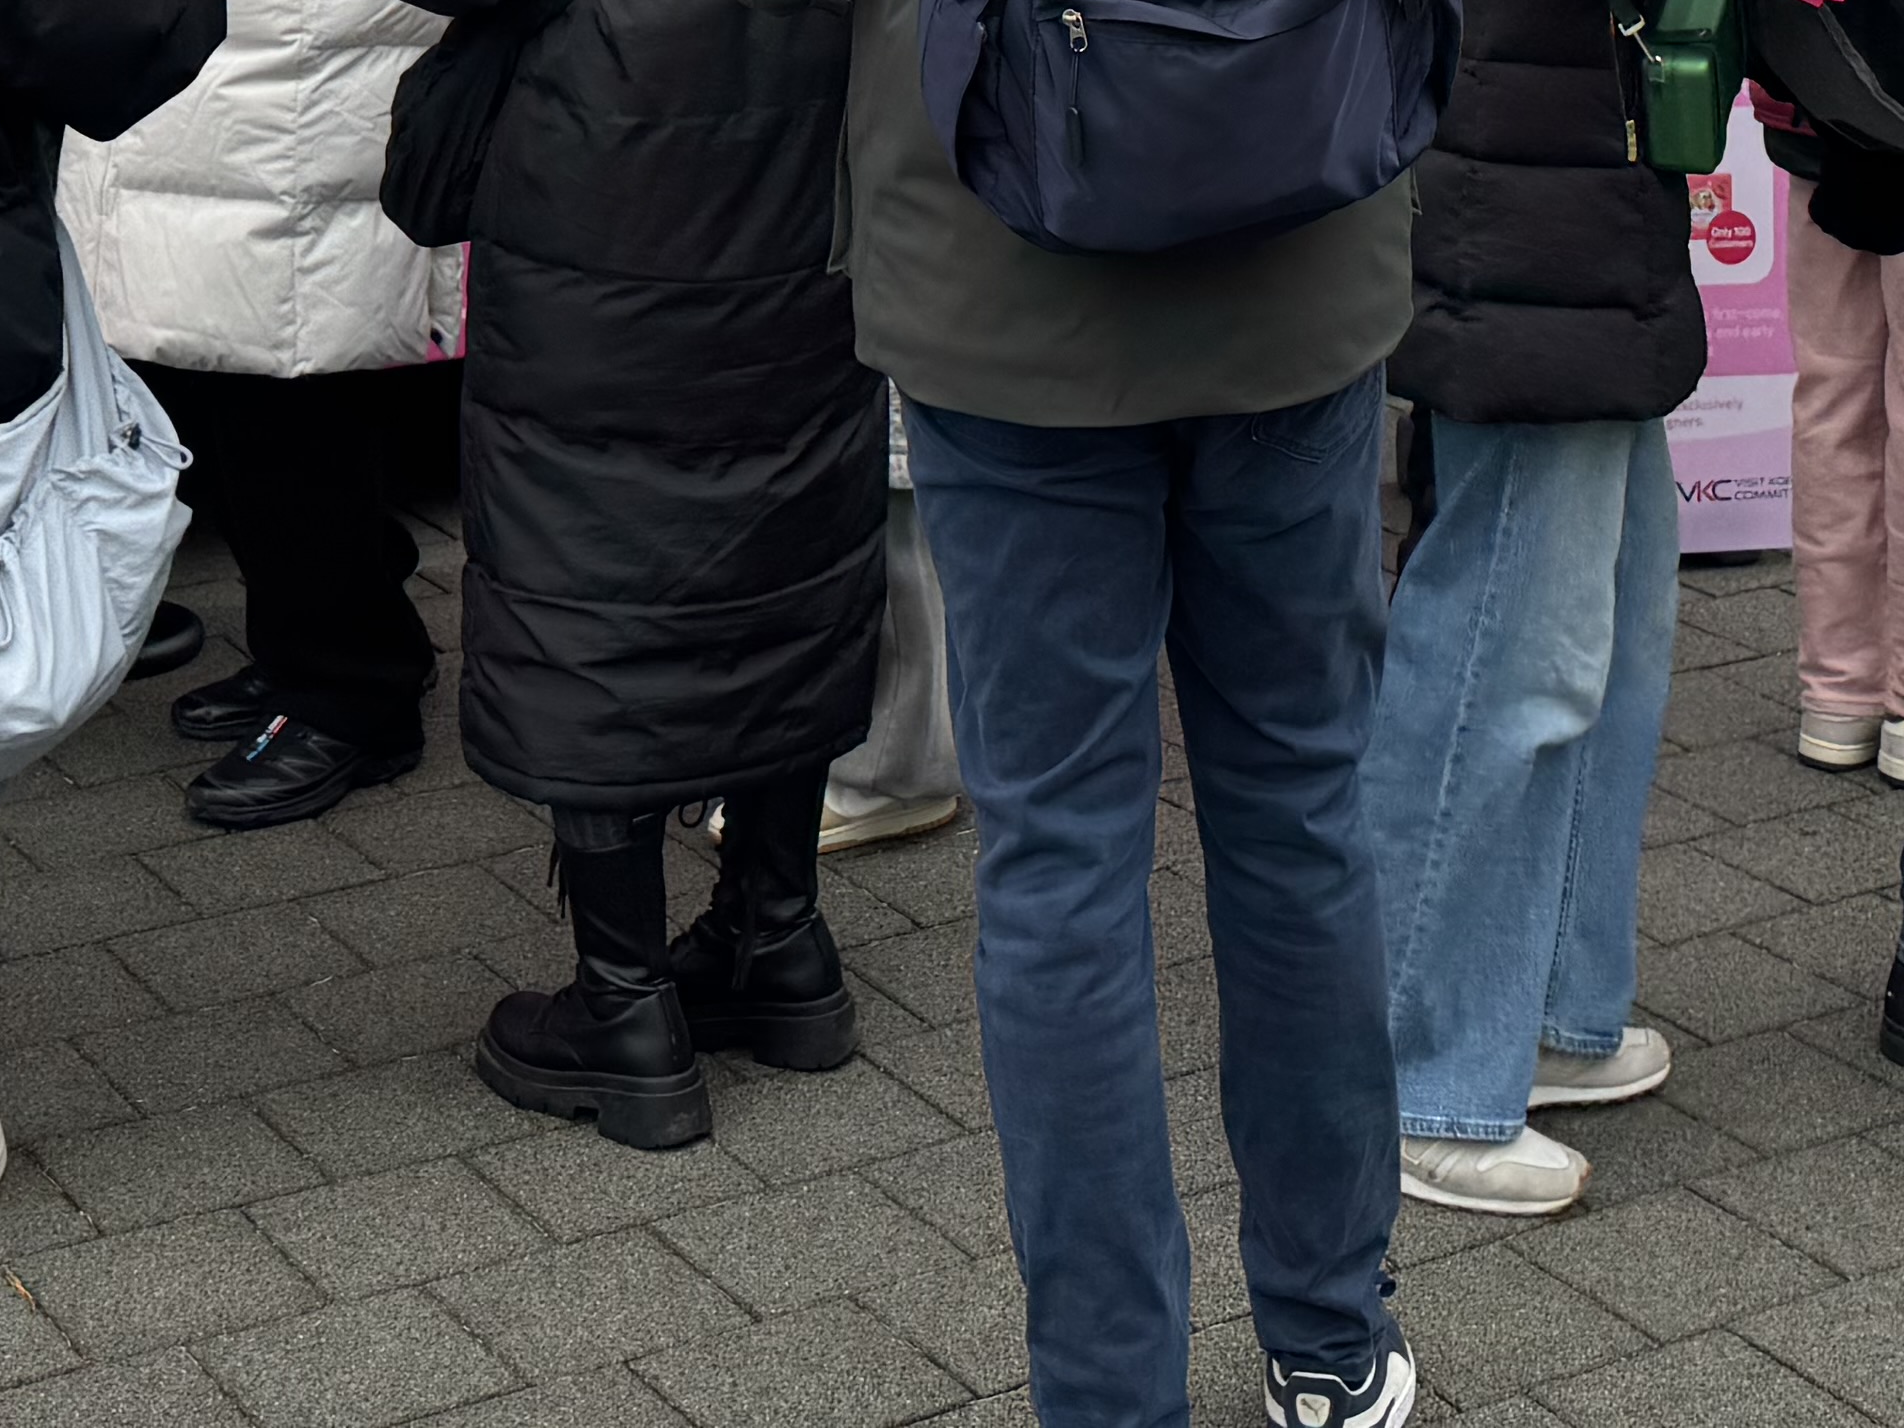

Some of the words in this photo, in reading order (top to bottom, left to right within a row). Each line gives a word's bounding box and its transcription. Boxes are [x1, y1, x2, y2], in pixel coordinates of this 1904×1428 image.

[1677, 398, 1744, 412] xclusively
[1675, 478, 1733, 503] VKC
[1733, 488, 1789, 501] COMMIT
